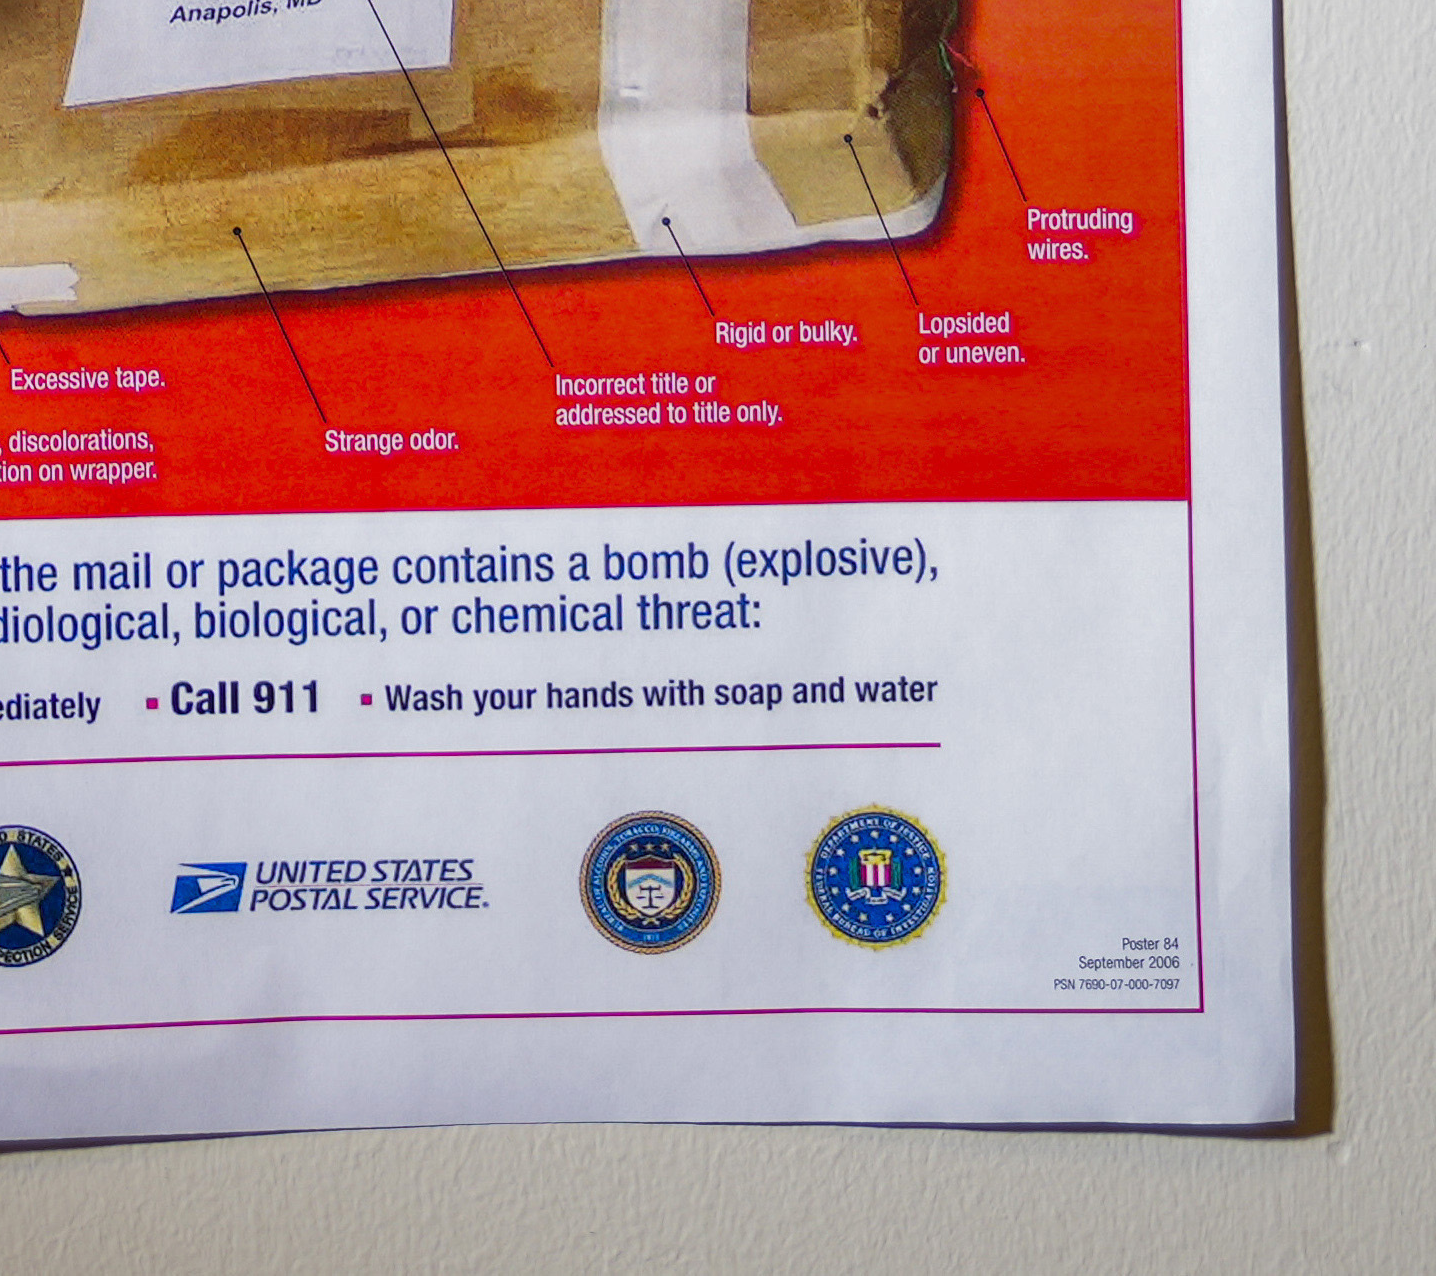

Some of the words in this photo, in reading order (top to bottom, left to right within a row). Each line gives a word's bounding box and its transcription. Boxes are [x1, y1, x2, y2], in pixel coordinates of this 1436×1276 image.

[1027, 207, 1134, 235] Protruding
[1026, 237, 1090, 261] wires.
[10, 366, 110, 391] Excessive
[114, 366, 166, 393] tape.
[73, 551, 151, 590] mail
[166, 559, 205, 589] or
[218, 549, 379, 597] package
[392, 544, 555, 585] contains
[568, 552, 591, 582] a
[604, 541, 709, 581] bomb
[724, 537, 938, 588] (explosive),
[171, 680, 240, 716] Call
[253, 679, 318, 714] 911
[384, 683, 463, 712] Wash
[472, 688, 537, 717] your
[546, 680, 634, 710] hands
[642, 678, 705, 707] with
[714, 683, 783, 712] soap
[792, 675, 845, 704] and
[854, 675, 939, 703] water
[255, 860, 367, 885] UNITED
[370, 858, 474, 883] STATES
[249, 887, 359, 912] POSTAL
[1122, 937, 1160, 951] Poster
[1163, 937, 1179, 951] 84
[1078, 955, 1146, 972] September
[1148, 955, 1180, 969] 2006
